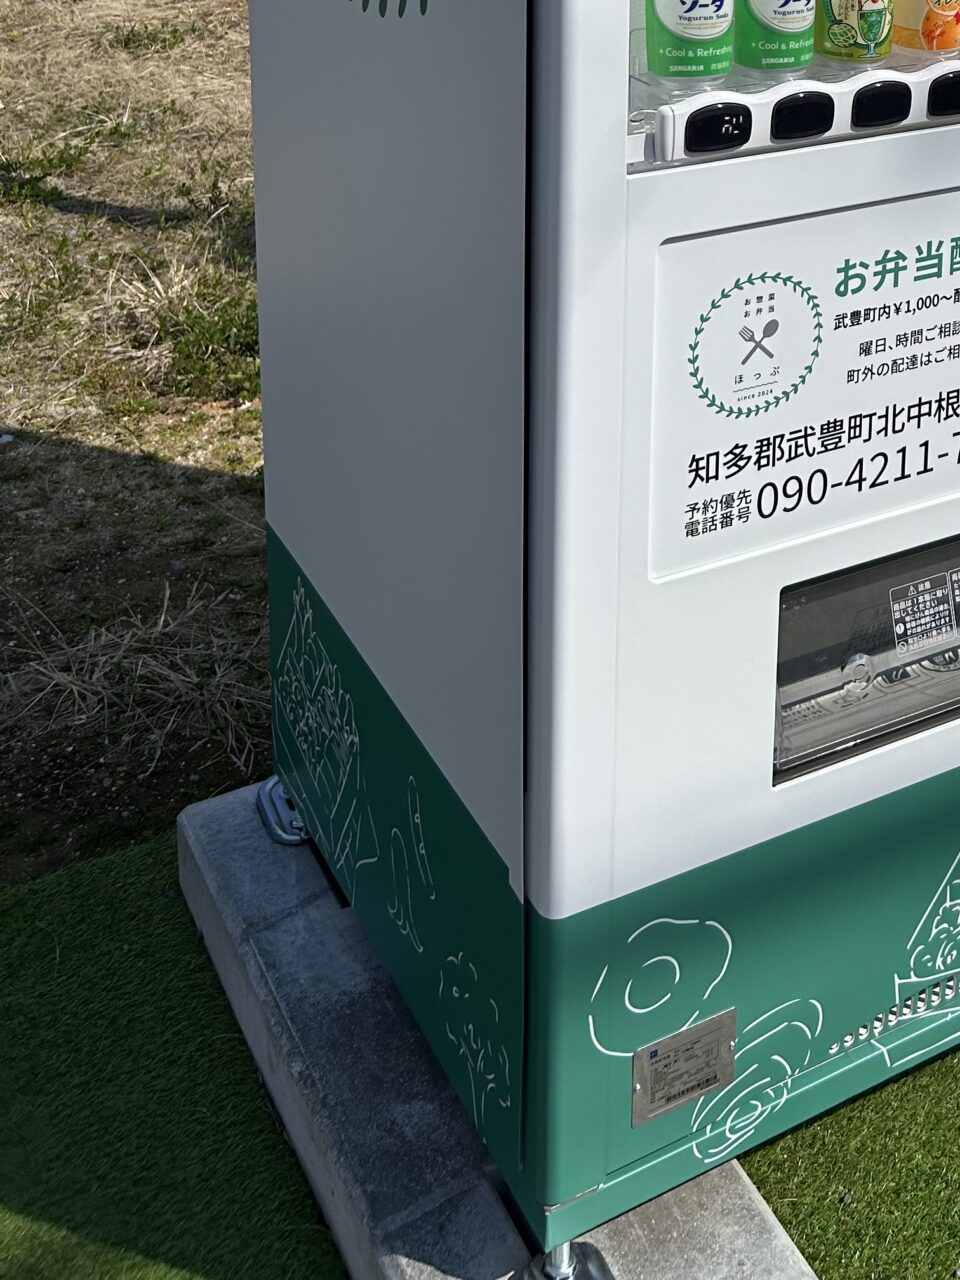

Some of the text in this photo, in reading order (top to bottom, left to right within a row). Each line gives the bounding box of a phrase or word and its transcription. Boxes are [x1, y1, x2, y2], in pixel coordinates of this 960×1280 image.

[678, 14, 714, 23] Yogurun
[773, 8, 805, 17] Yogurun
[665, 47, 686, 57] Cool
[758, 41, 779, 50] Cool
[744, 292, 775, 306] お惣菜
[743, 304, 775, 318] お弁当
[737, 388, 774, 402] since 2024
[684, 488, 752, 520] 予約優先
[684, 505, 752, 538] 電話番号
